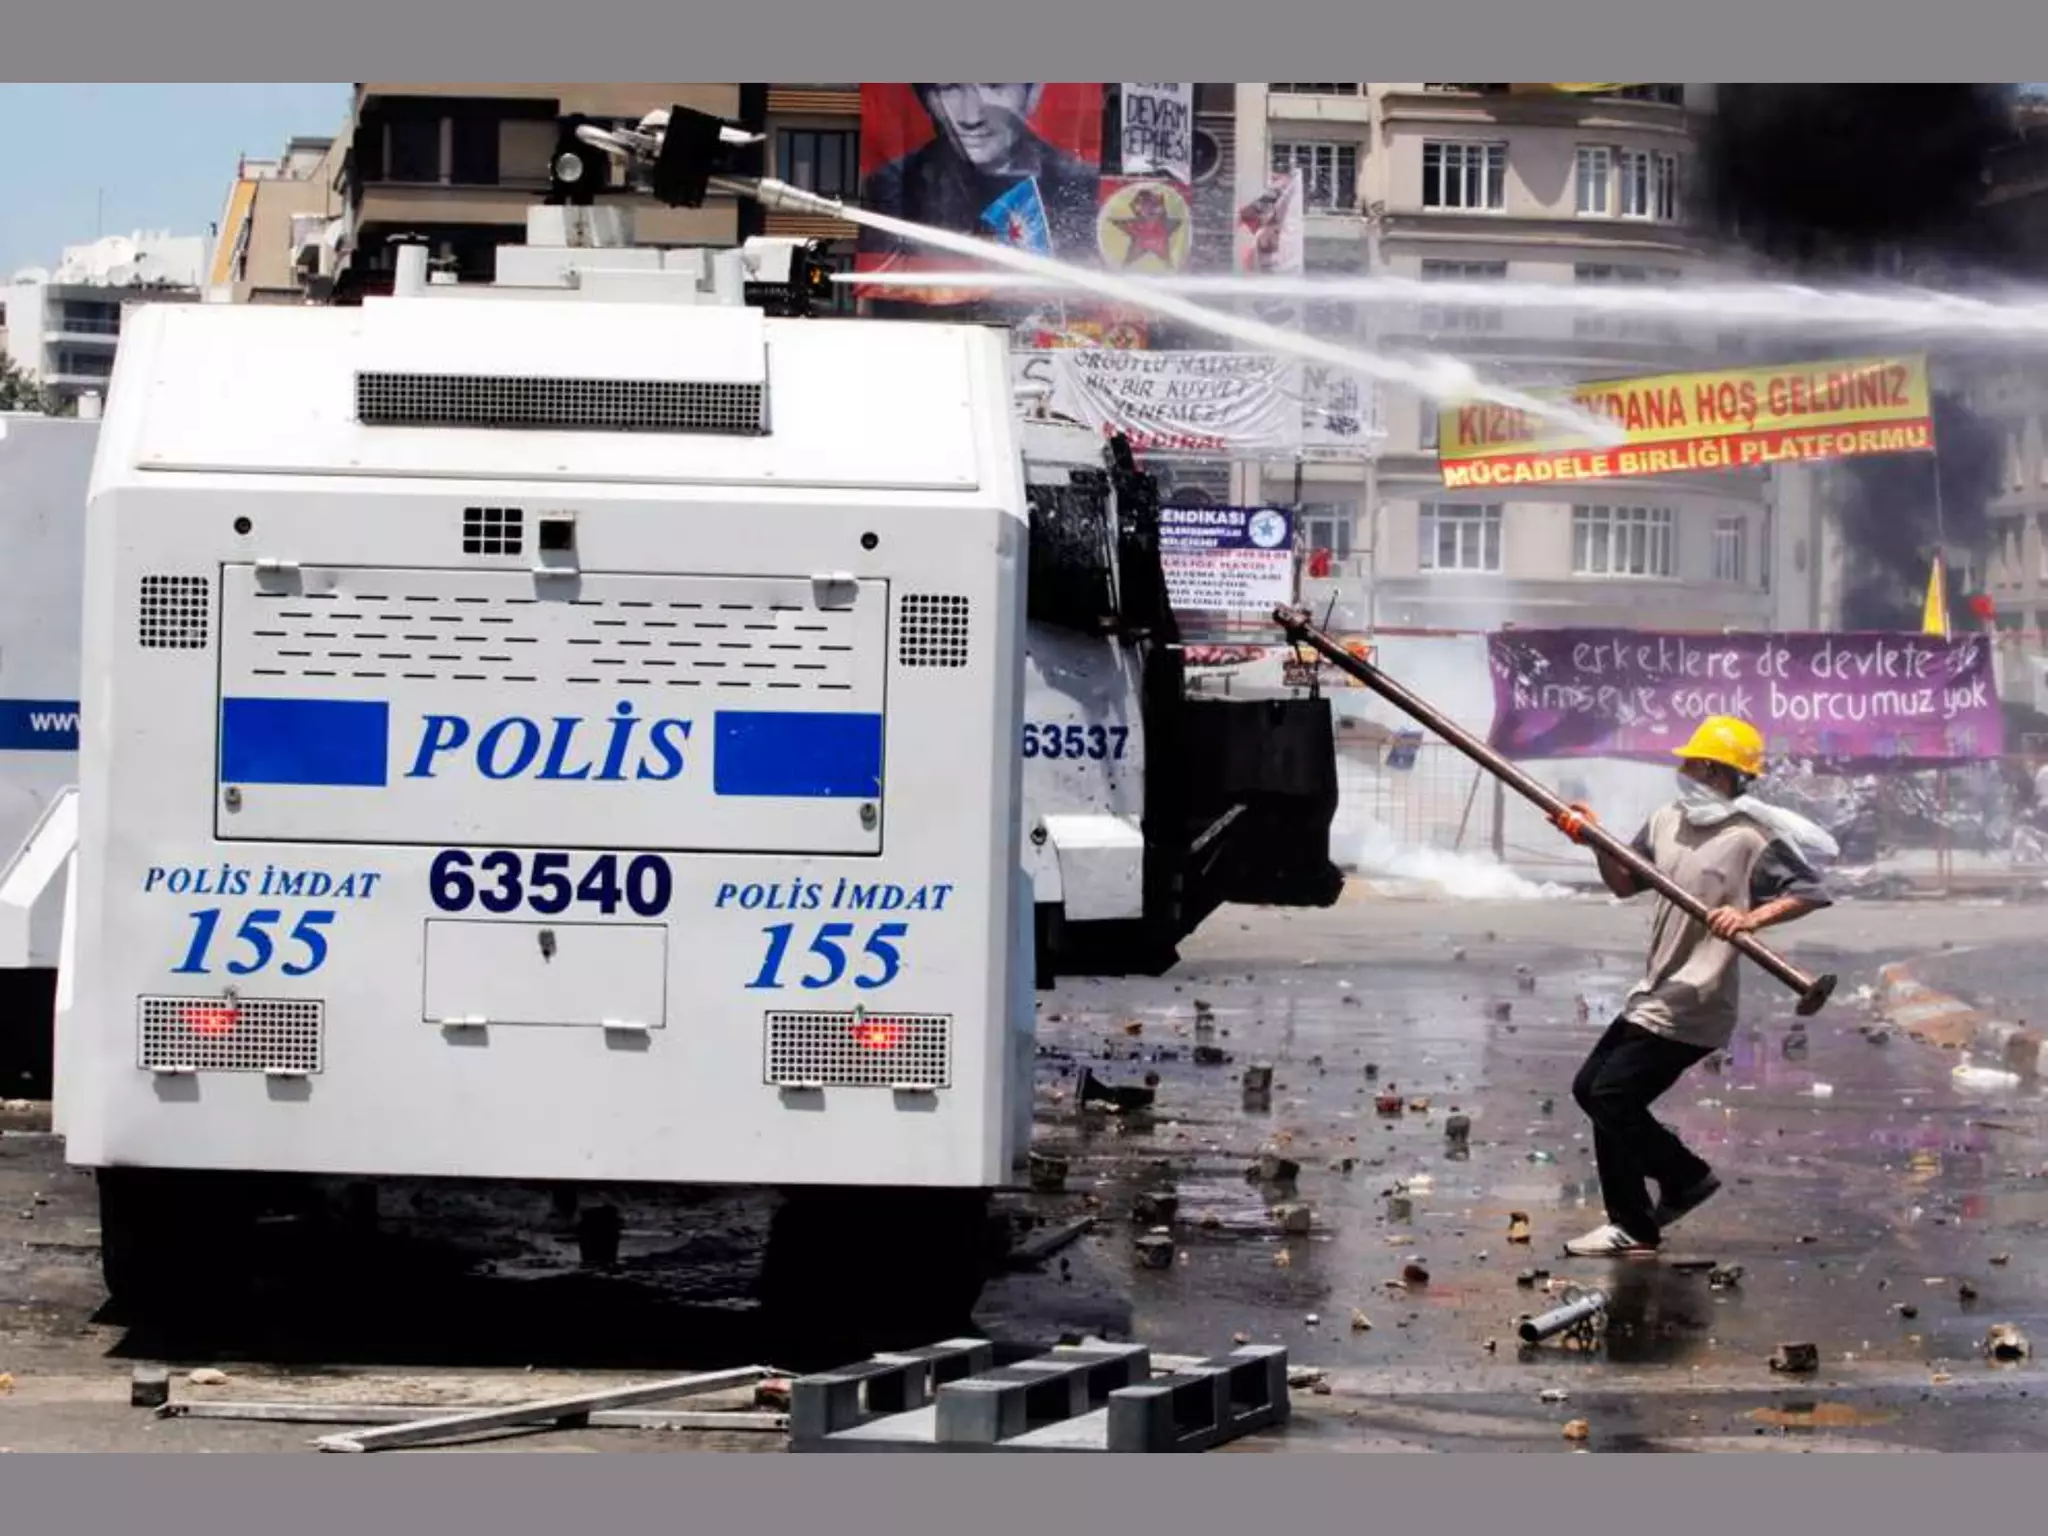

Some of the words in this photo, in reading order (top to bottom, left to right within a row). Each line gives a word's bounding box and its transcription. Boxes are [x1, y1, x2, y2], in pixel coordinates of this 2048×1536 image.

[1572, 386, 1688, 431] YDANA
[1695, 380, 1758, 431] HOŞ
[1443, 454, 1610, 489] MÜCADELE
[1739, 424, 1929, 465] PLATFORMU
[1756, 640, 1791, 679] de
[1810, 640, 1934, 680] devlete
[1770, 680, 1936, 721] borcumuz
[1943, 674, 1989, 719] yok
[403, 700, 693, 781] POLİS
[1022, 723, 1129, 760] 63537
[145, 863, 252, 895] POLİS
[258, 864, 381, 898] İMDAT
[429, 849, 673, 917] 63540
[714, 877, 823, 909] POLİS
[831, 877, 954, 911] İMDAT
[170, 908, 337, 976] 155
[744, 922, 910, 989] 155
